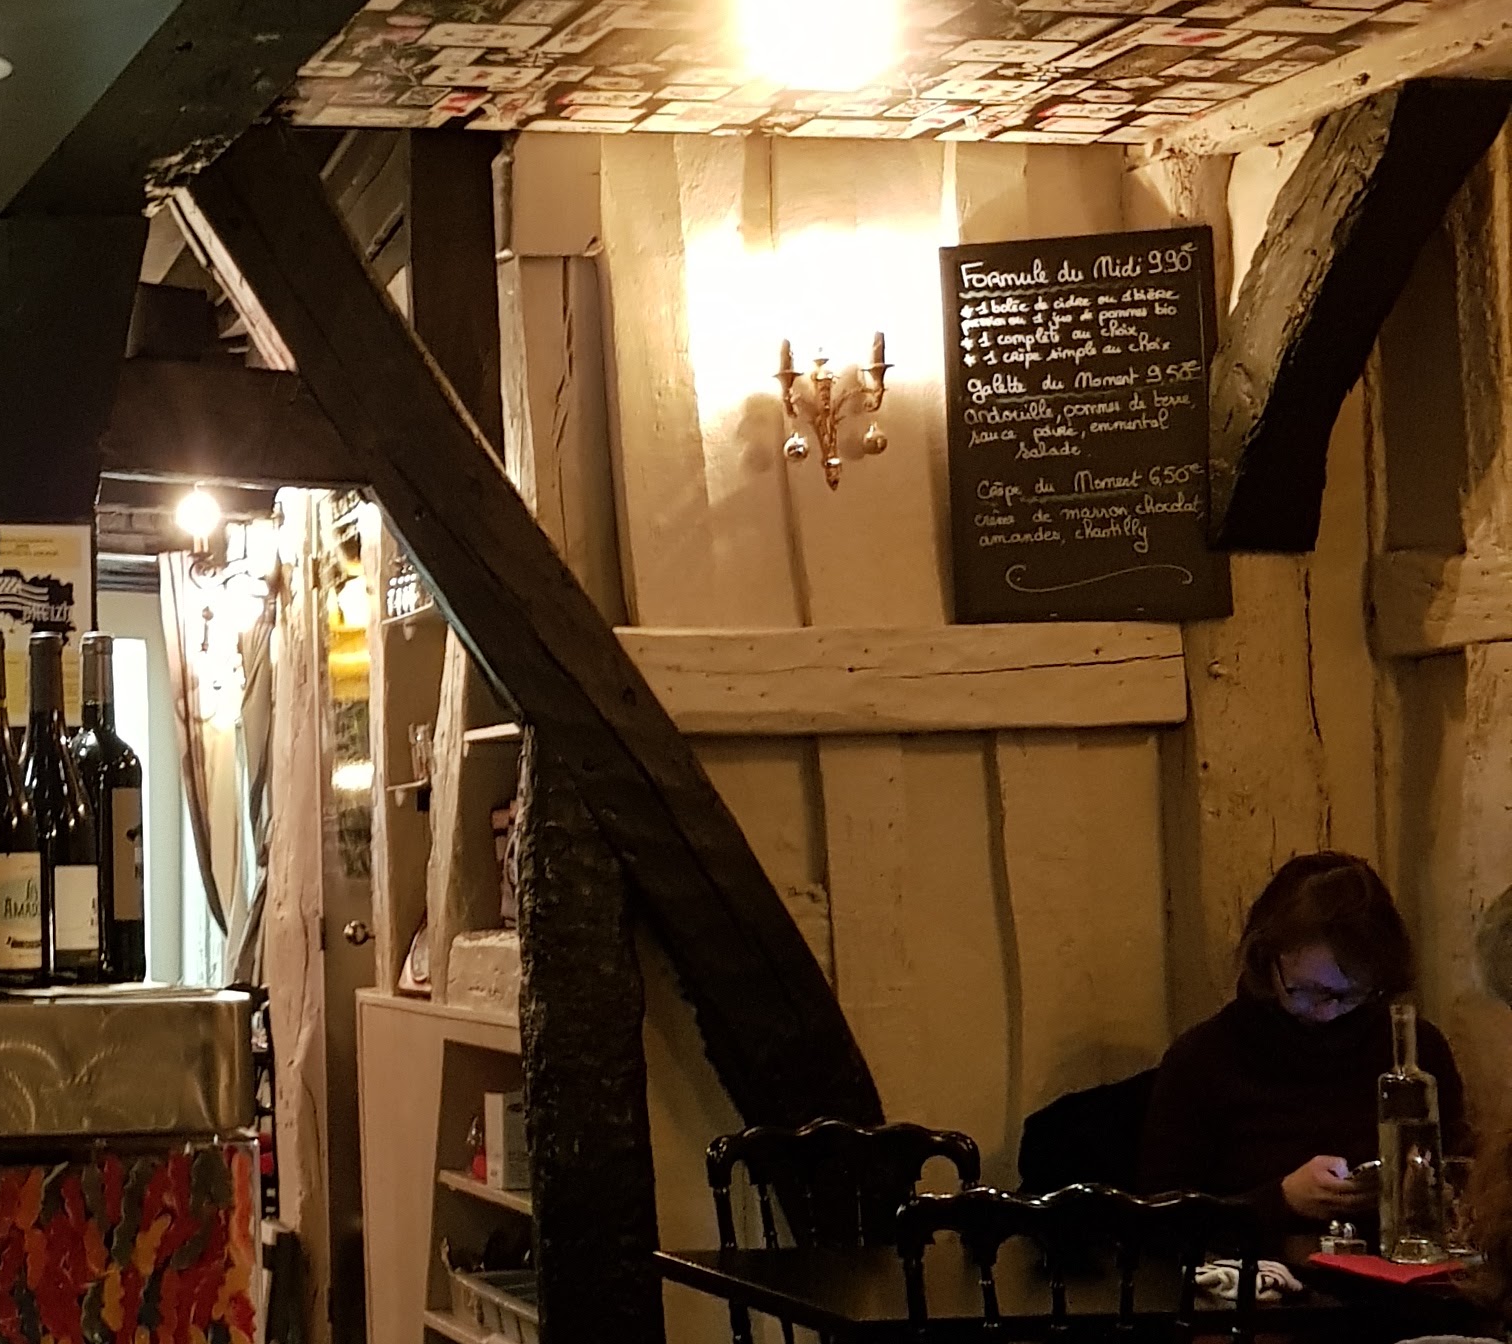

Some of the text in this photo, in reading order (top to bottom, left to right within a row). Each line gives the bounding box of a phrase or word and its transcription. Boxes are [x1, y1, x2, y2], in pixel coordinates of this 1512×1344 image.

[1057, 259, 1084, 283] du
[1093, 255, 1142, 279] Midi
[1053, 294, 1092, 309] cidre
[1097, 295, 1118, 305] ou
[1154, 302, 1177, 316] bio
[1071, 329, 1092, 340] au
[1100, 319, 1138, 337] choix
[1046, 340, 1097, 366] simple
[1102, 344, 1122, 354] au
[1128, 331, 1171, 352] choix
[1041, 374, 1065, 390] du
[1074, 365, 1140, 388] Moment
[1128, 392, 1147, 412] de
[967, 429, 1018, 448] sauce
[1089, 408, 1169, 433] emmental
[976, 480, 1022, 506] Crêpe
[1034, 477, 1055, 494] du
[1074, 469, 1143, 493] Moment
[1032, 508, 1053, 523] de
[1074, 516, 1148, 553] chantilly
